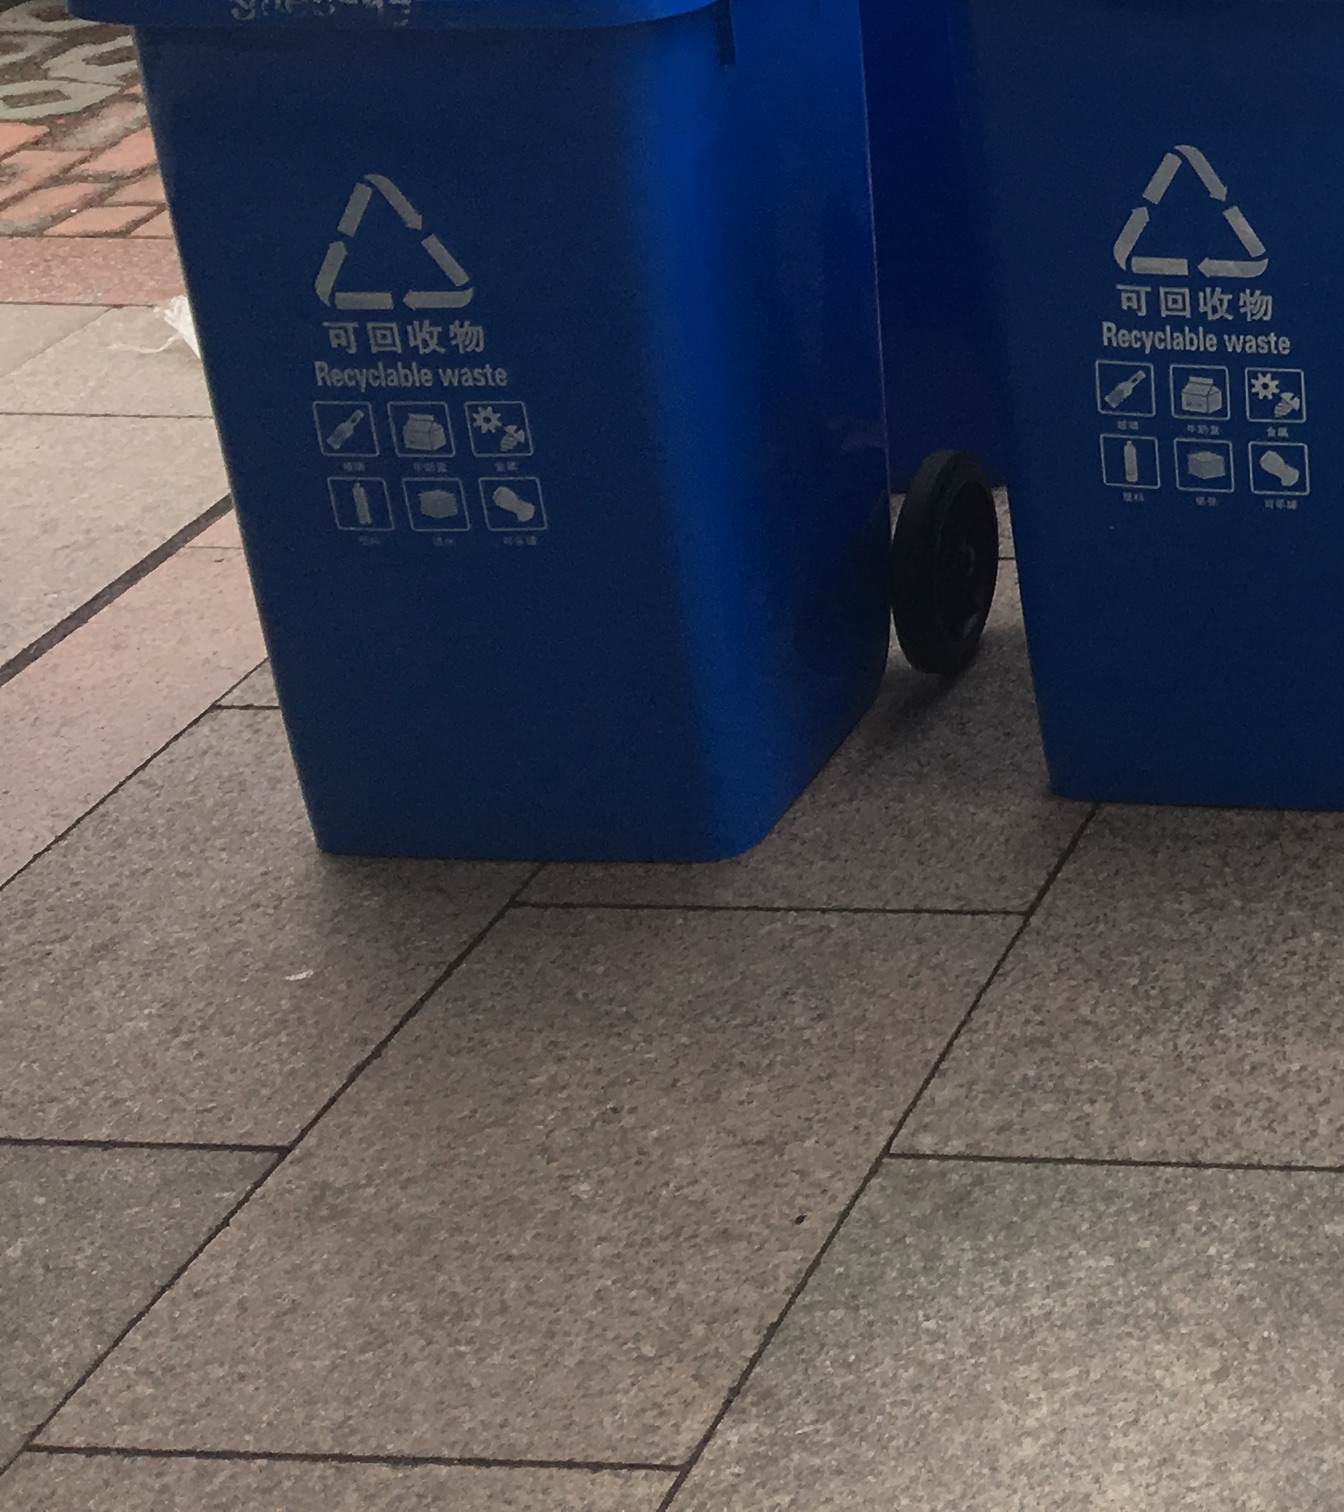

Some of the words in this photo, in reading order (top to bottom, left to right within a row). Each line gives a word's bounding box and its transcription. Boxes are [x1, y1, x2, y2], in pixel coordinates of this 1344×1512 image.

[1116, 284, 1273, 321] 可回收物
[322, 320, 486, 354] 可回收物
[1102, 321, 1217, 354] Recyclable
[1223, 331, 1291, 355] waste
[313, 361, 433, 392] Recyclable
[438, 364, 509, 387] waste
